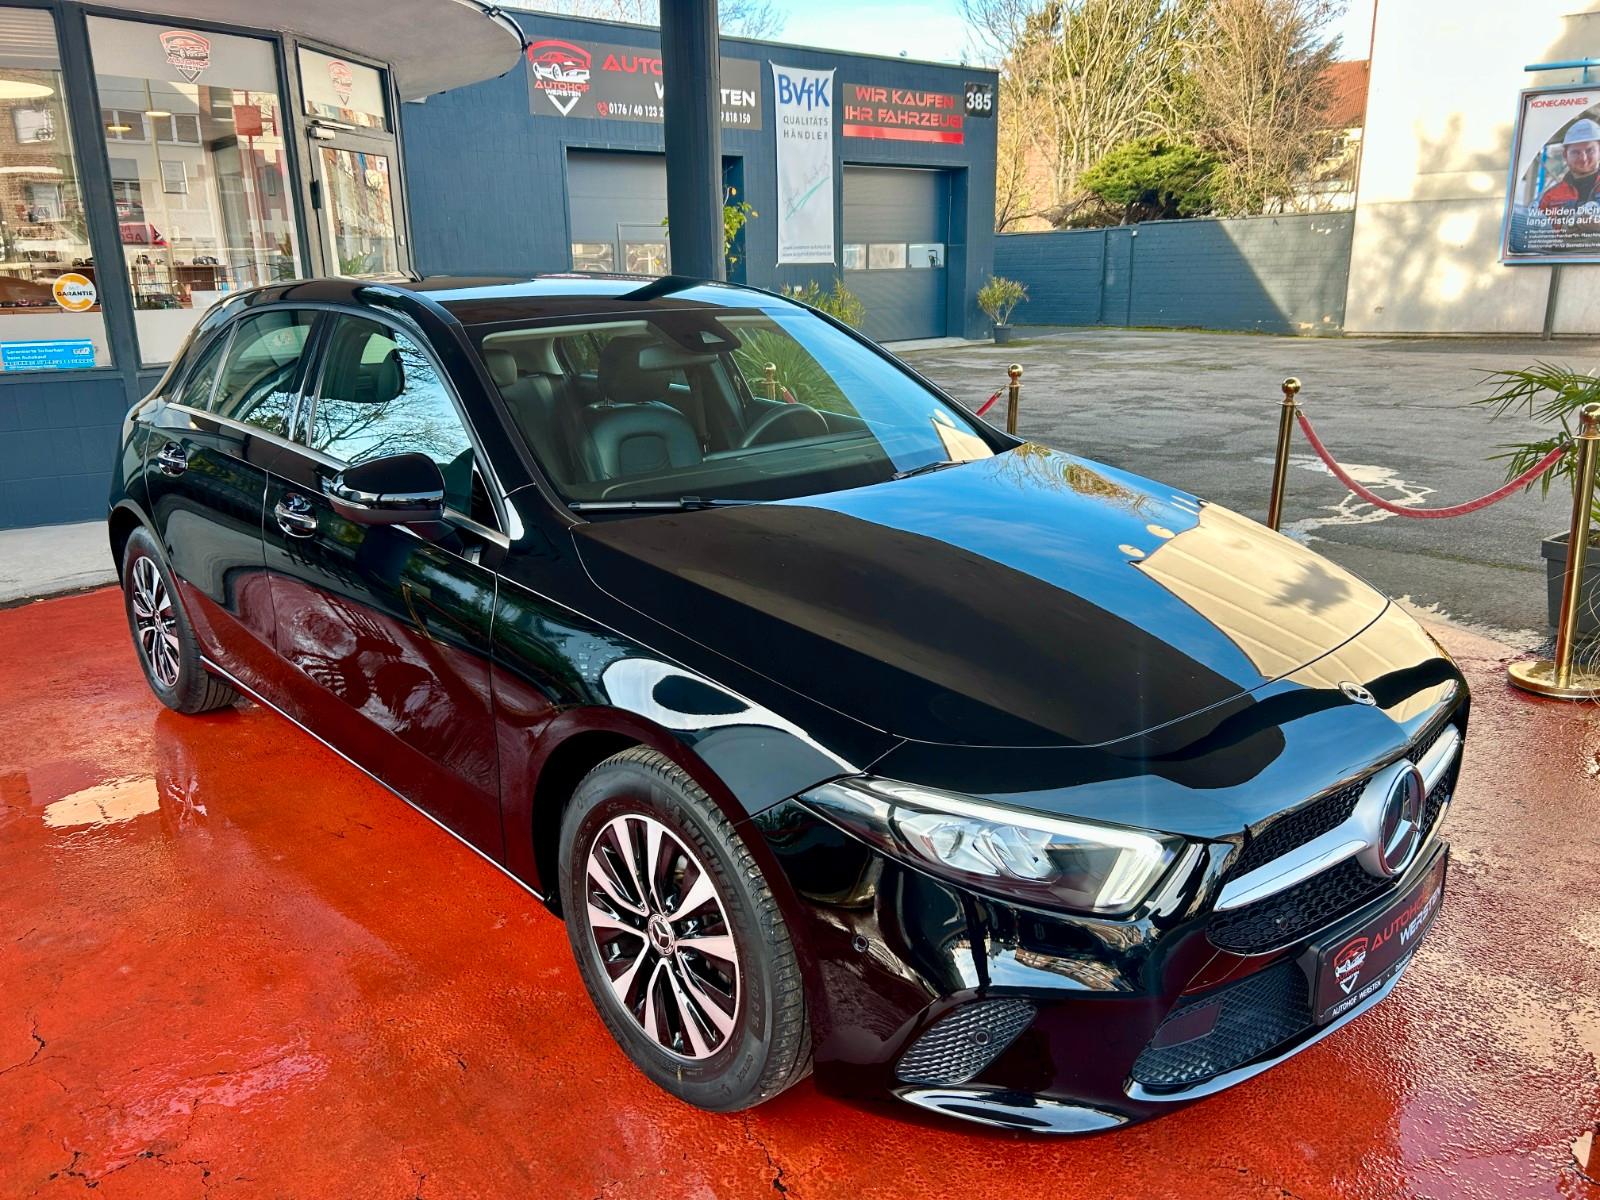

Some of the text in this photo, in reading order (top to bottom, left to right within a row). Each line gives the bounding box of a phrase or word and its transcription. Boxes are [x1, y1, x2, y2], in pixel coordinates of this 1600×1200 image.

[601, 53, 664, 76] AUTO
[534, 80, 590, 92] AUTOHOF
[855, 86, 955, 109] WIR KAUFEN
[966, 92, 992, 111] 385
[1531, 97, 1588, 108] KONECRANES
[609, 101, 627, 115] 0176
[633, 104, 643, 117] 40
[644, 105, 658, 118] 123
[739, 114, 751, 124] 150
[844, 105, 873, 121] IHR
[783, 115, 829, 127] QUALITÄTS
[1528, 207, 1544, 217] Wir
[1545, 206, 1576, 216] bilden
[1526, 216, 1575, 227] langfristig
[1576, 214, 1593, 224] auf
[1331, 995, 1358, 1017] AUTOHOF
